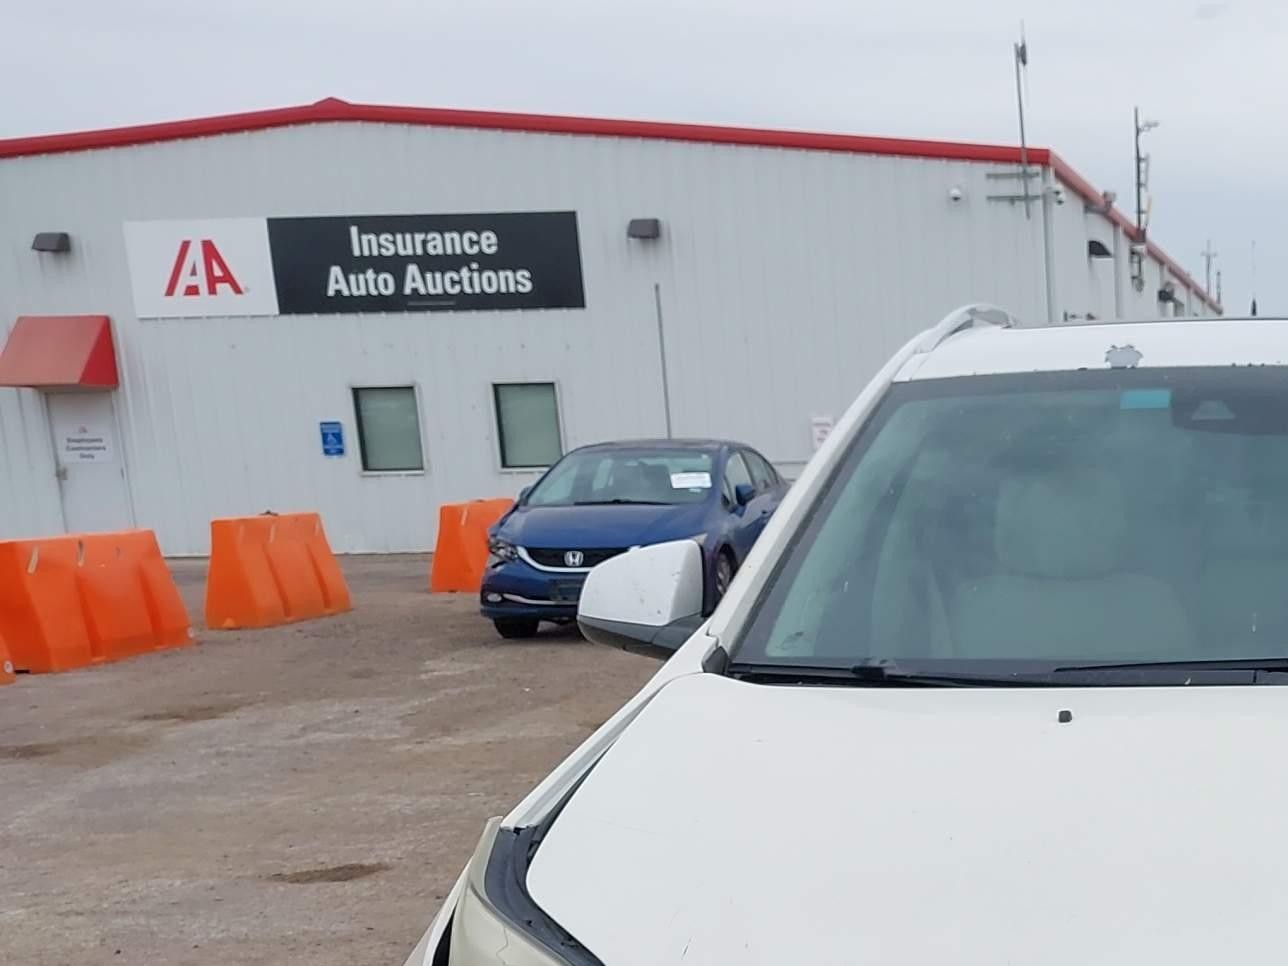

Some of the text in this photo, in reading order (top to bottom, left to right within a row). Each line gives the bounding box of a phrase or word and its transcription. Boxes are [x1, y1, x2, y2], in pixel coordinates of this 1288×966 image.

[349, 225, 499, 258] Insurance
[326, 262, 534, 298] Auto Auctions
